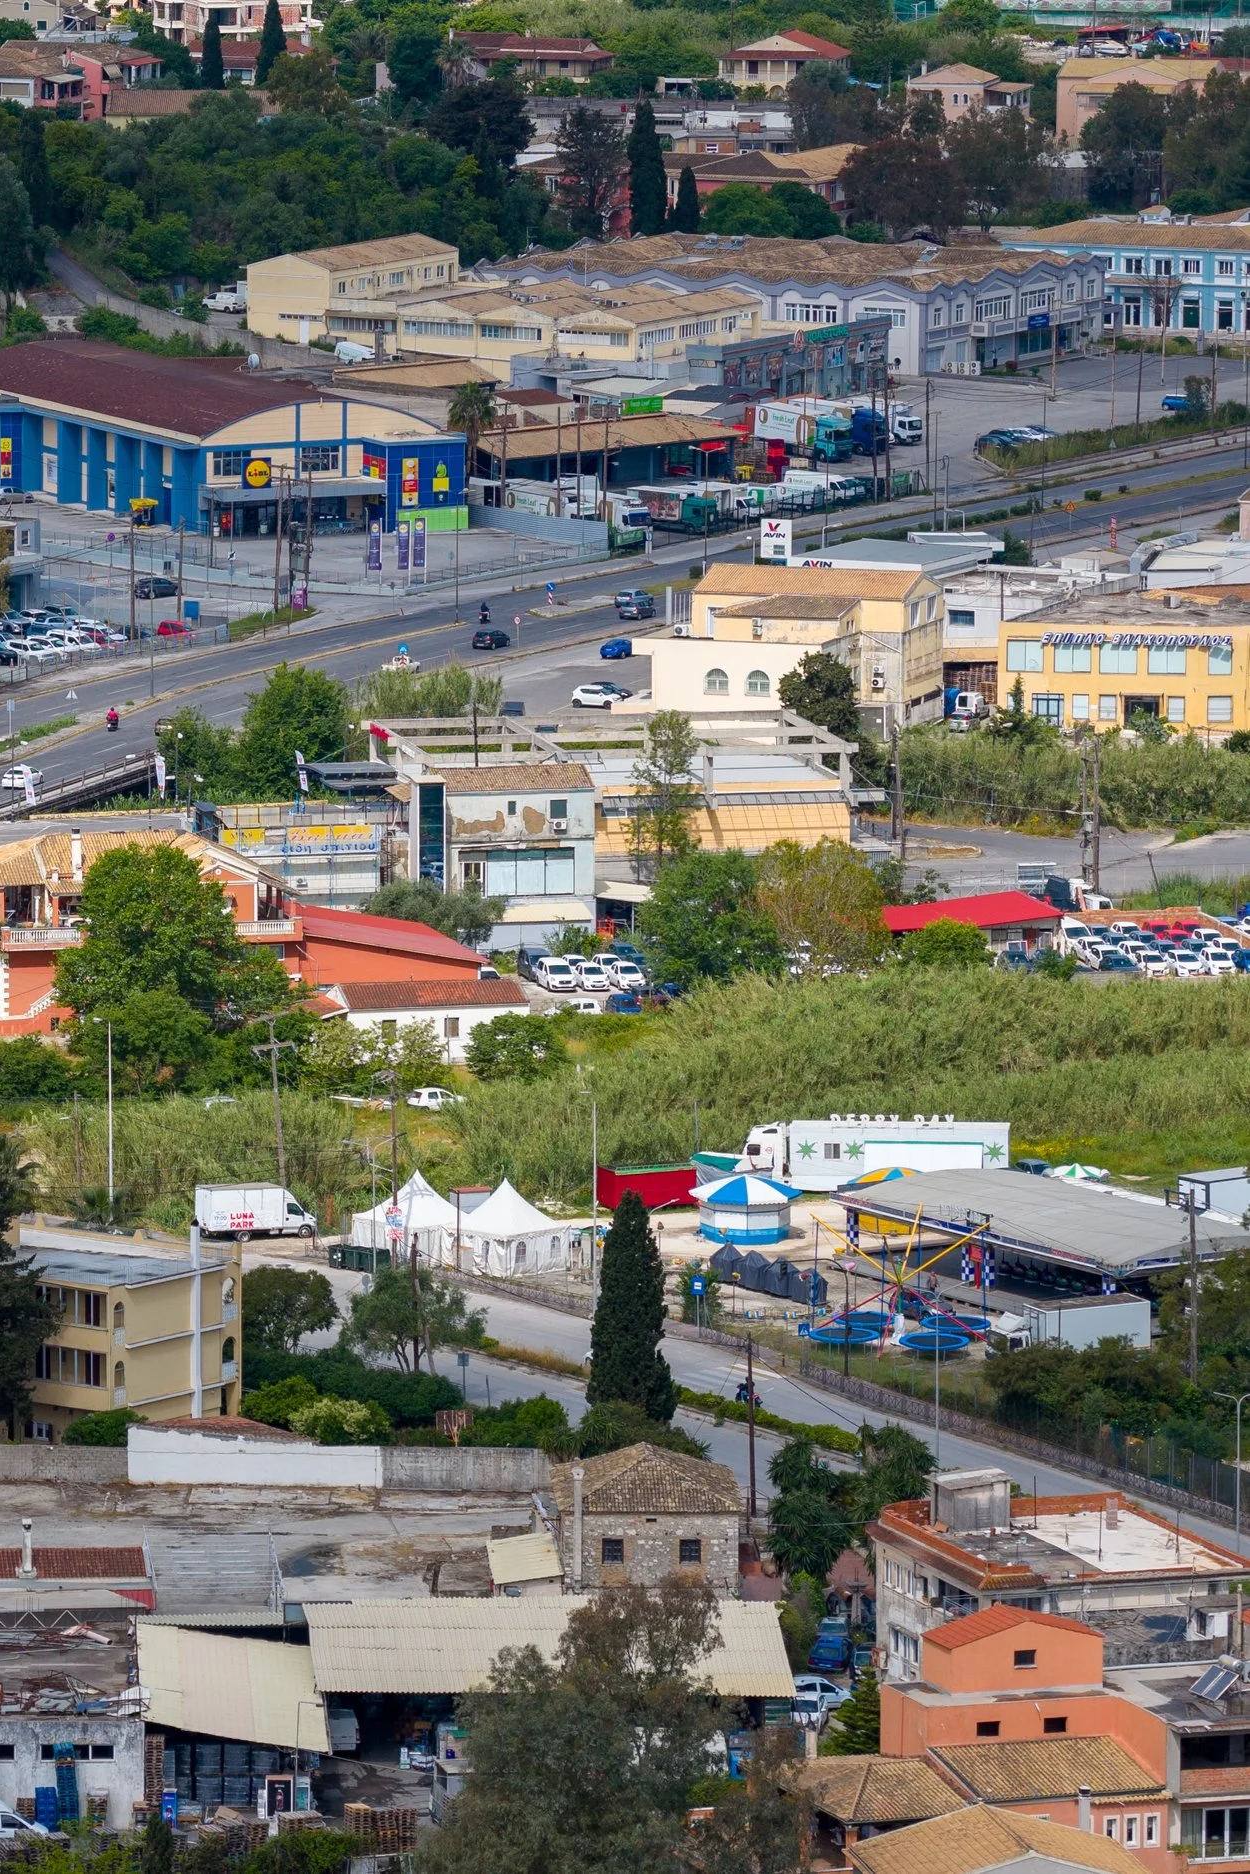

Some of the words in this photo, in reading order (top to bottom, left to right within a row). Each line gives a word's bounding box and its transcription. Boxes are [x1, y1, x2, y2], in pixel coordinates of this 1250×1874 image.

[802, 560, 833, 568] AVIN
[1041, 632, 1106, 644] ΕΠΙΠΛΟ
[230, 1212, 255, 1220] LUNA
[230, 1221, 255, 1229] PARK
